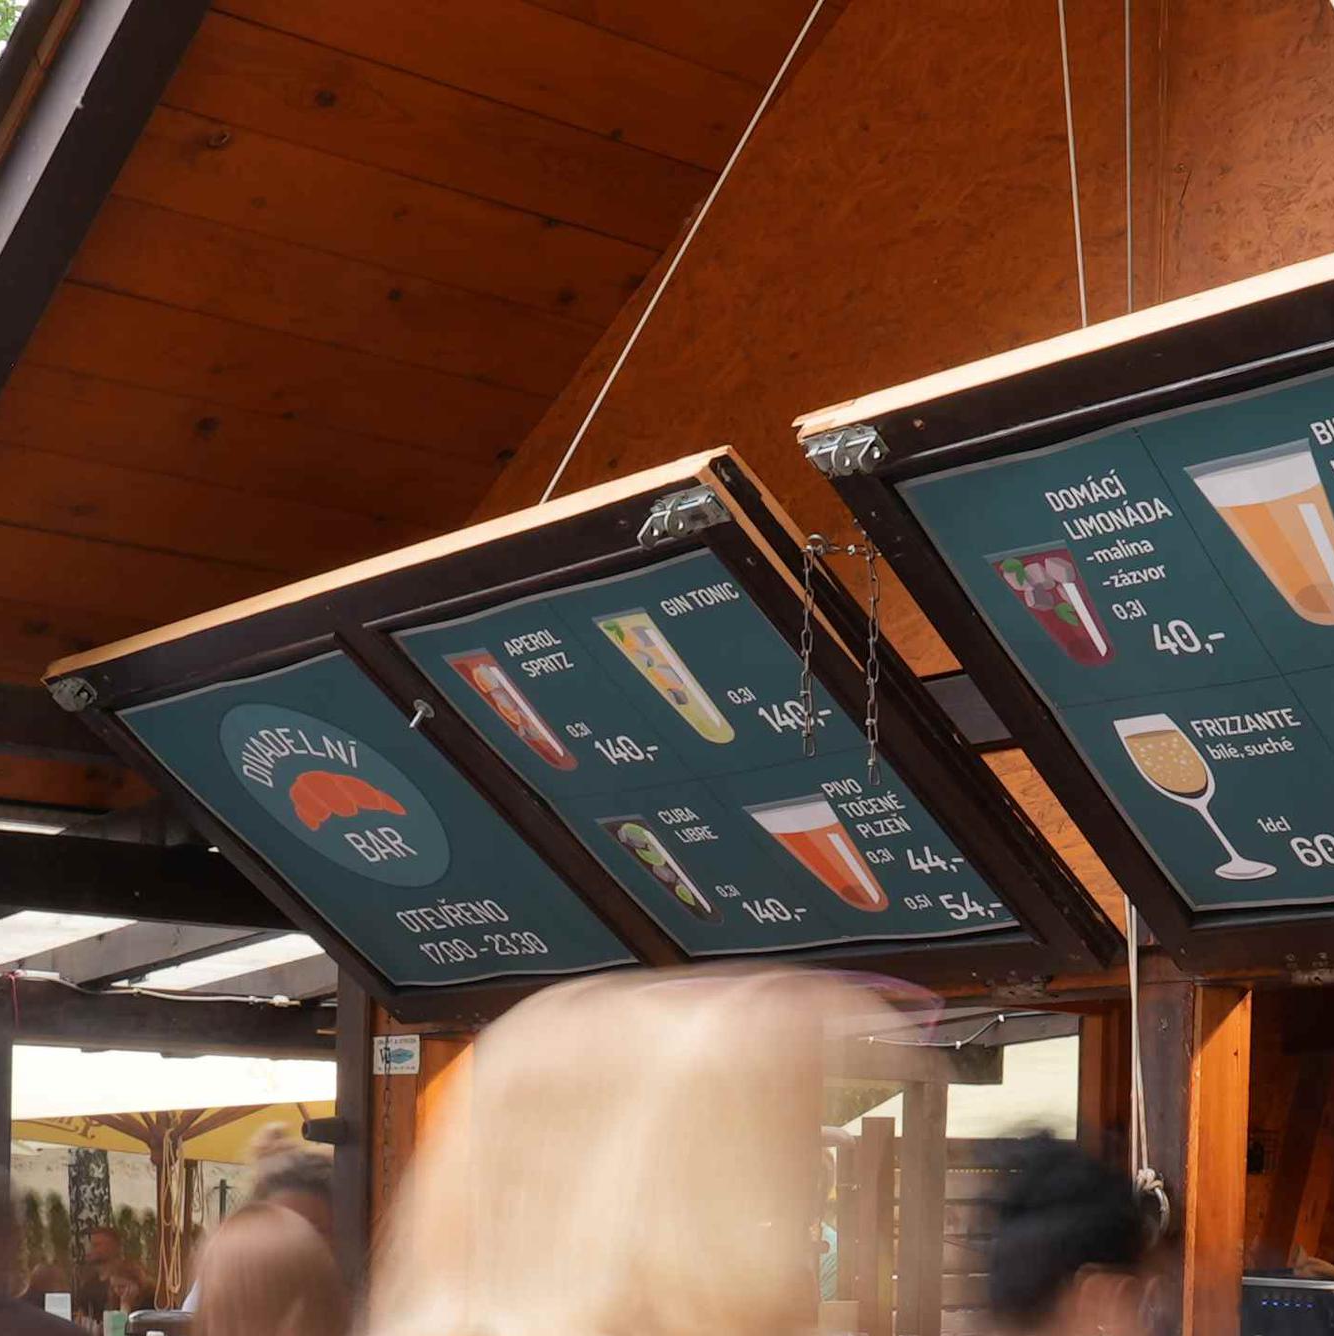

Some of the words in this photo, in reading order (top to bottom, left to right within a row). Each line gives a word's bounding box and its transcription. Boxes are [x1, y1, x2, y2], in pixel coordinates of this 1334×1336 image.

[1045, 470, 1128, 514] DOMÁCÍ
[1063, 497, 1172, 542] LIMONÁDA
[660, 595, 692, 618] GIN
[689, 582, 740, 611] TONIC
[503, 628, 562, 657] APEROL
[1153, 619, 1226, 656] 40,-
[521, 652, 574, 679] SPRITZ
[1190, 707, 1302, 738] FRIZZANTE
[241, 726, 359, 789] DIVADELNÍ
[1206, 737, 1244, 761] bílé,
[1245, 733, 1295, 757] suché
[821, 778, 863, 799] PIVO
[658, 808, 699, 827] CUBA
[839, 791, 906, 817] TOČENÉ
[674, 825, 719, 843] LIBRE
[856, 815, 912, 839] PLZEŇ
[343, 825, 418, 865] BAR
[907, 846, 964, 873] 44,-
[396, 897, 510, 934] OTEVŘENO
[939, 893, 1004, 921] 54,-
